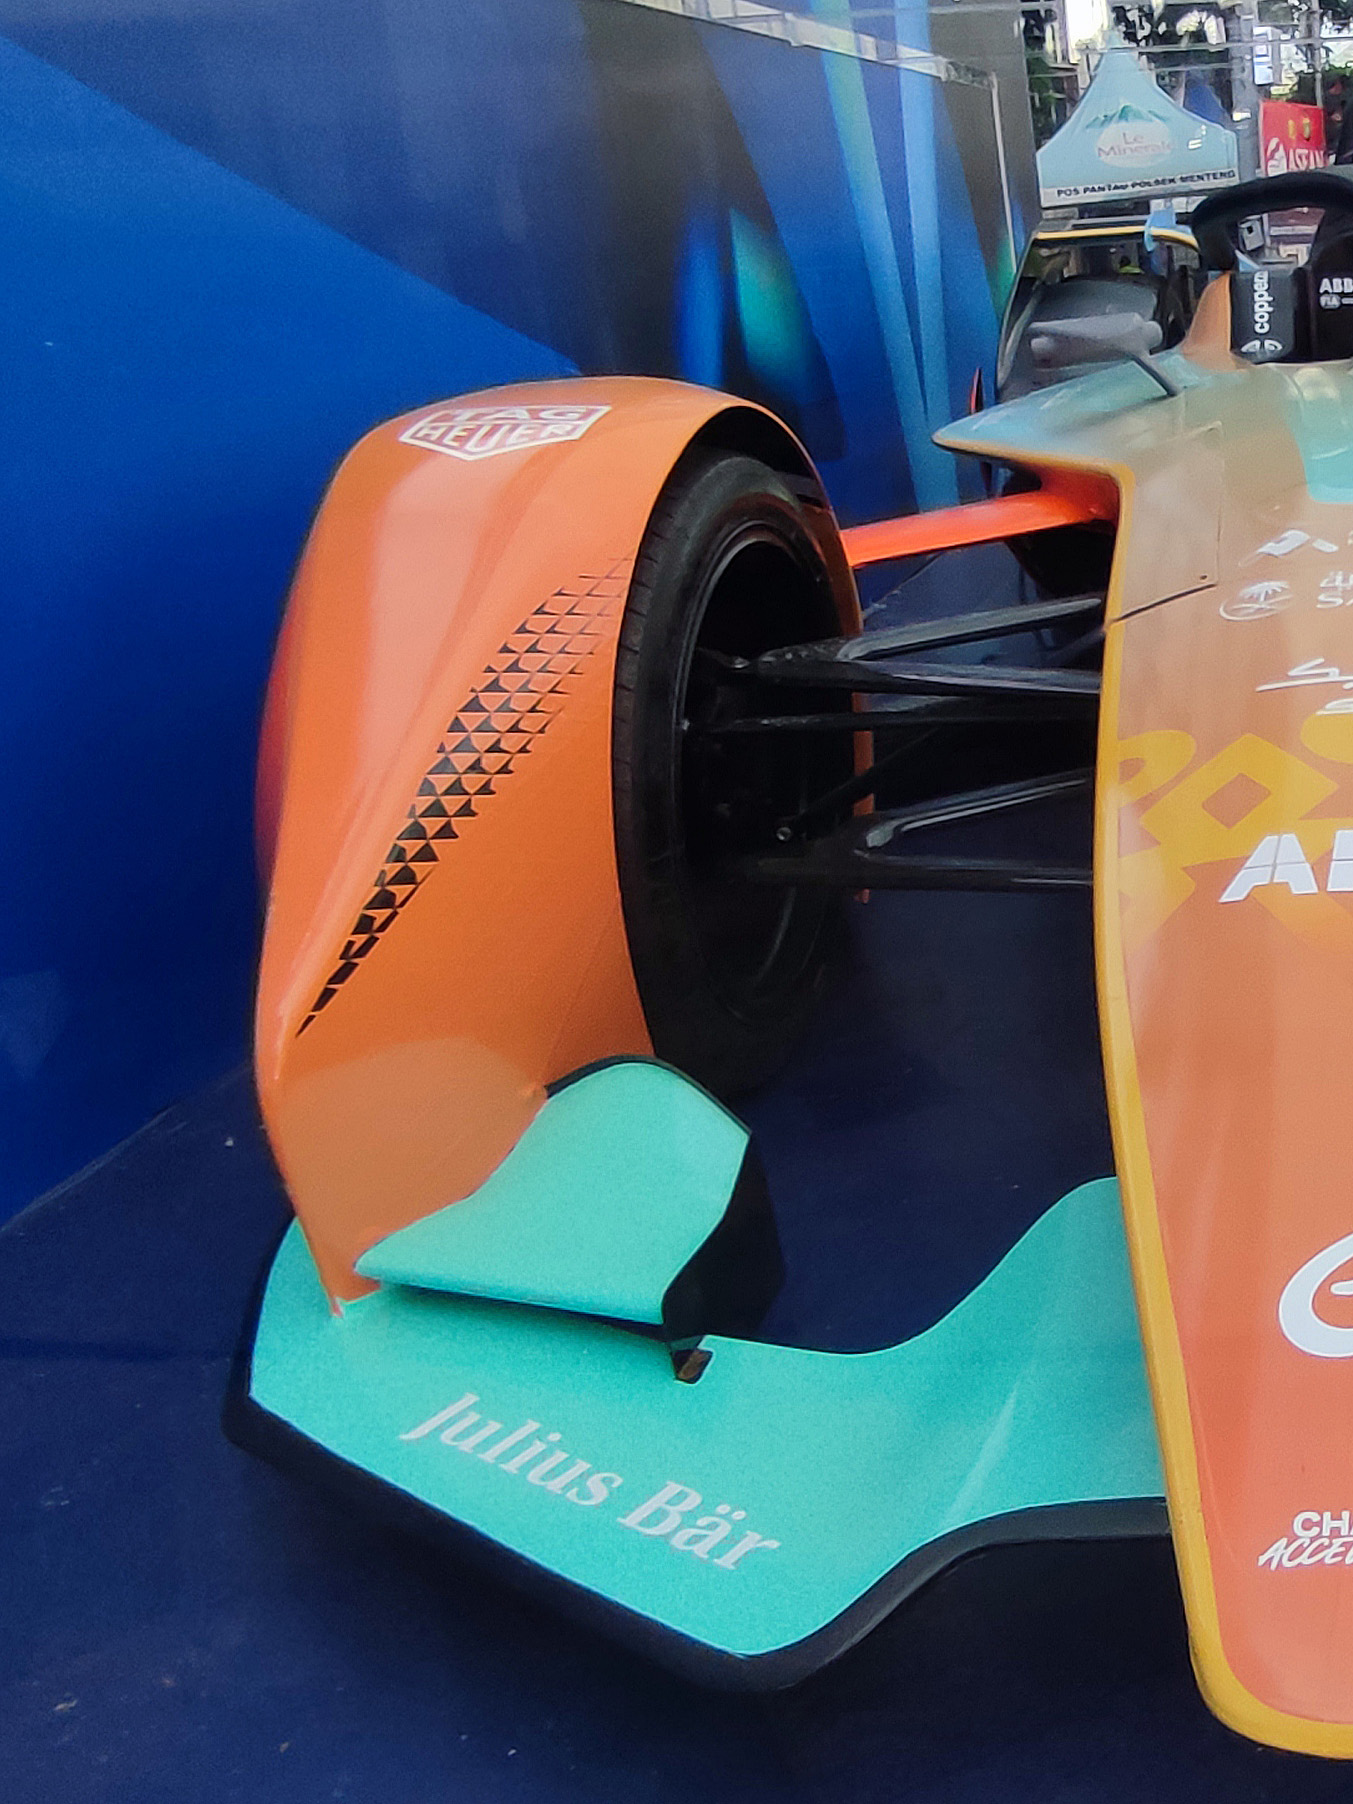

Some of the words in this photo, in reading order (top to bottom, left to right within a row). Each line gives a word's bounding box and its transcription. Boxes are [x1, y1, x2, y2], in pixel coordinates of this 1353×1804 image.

[1122, 131, 1144, 146] Le
[1057, 189, 1080, 198] POS
[1319, 277, 1353, 294] ABB
[452, 406, 588, 421] TAG
[415, 423, 576, 453] HEUER
[397, 1392, 625, 1506] Julius
[616, 1480, 782, 1570] Bär
